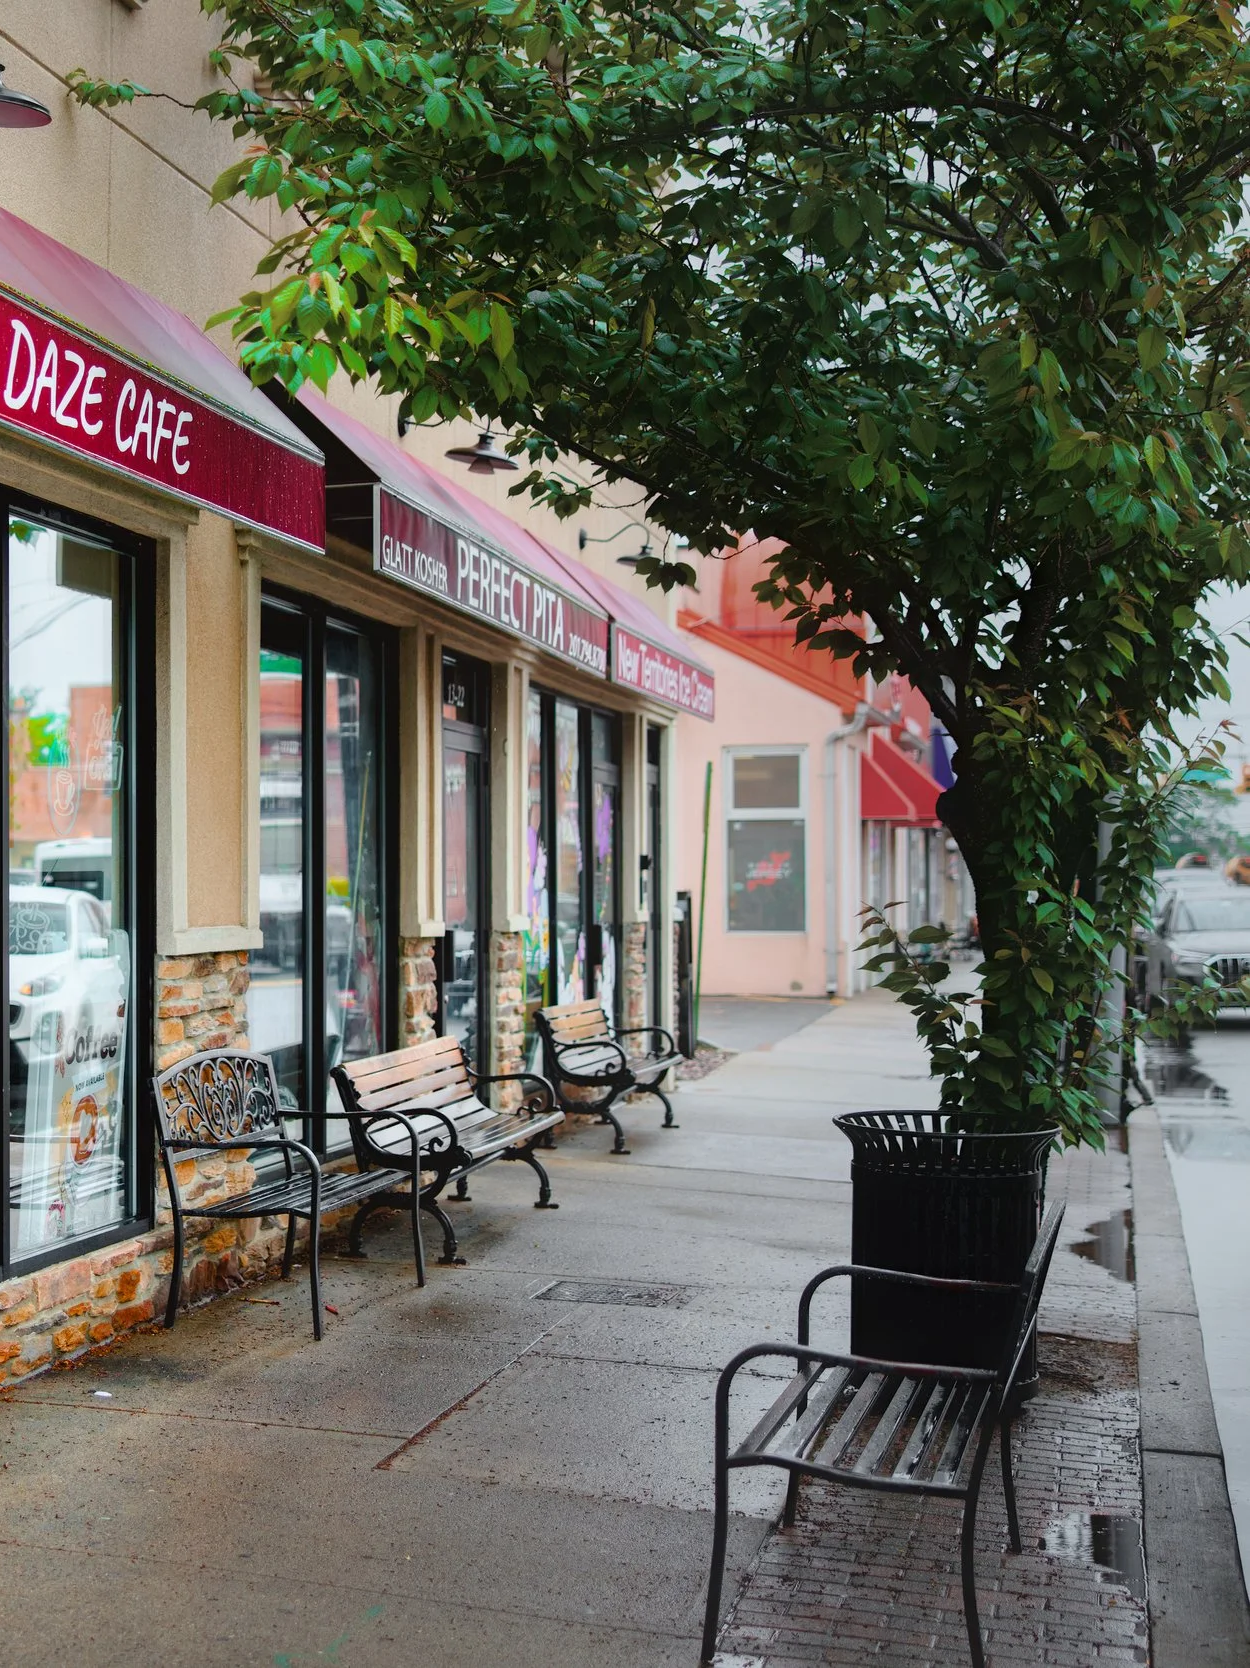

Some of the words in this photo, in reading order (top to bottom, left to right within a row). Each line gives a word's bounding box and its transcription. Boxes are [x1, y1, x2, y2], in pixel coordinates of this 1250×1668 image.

[3, 318, 107, 436] DAZE
[115, 378, 194, 475] CAFE
[382, 535, 413, 576] GLATT
[414, 549, 448, 592] KOSHER
[457, 539, 531, 632] PERFECT
[532, 583, 565, 652] PITA
[448, 683, 465, 708] 13-22
[617, 632, 640, 684] New
[678, 663, 691, 707] Ice
[691, 669, 713, 714] Cream
[65, 1025, 118, 1065] Coffee
